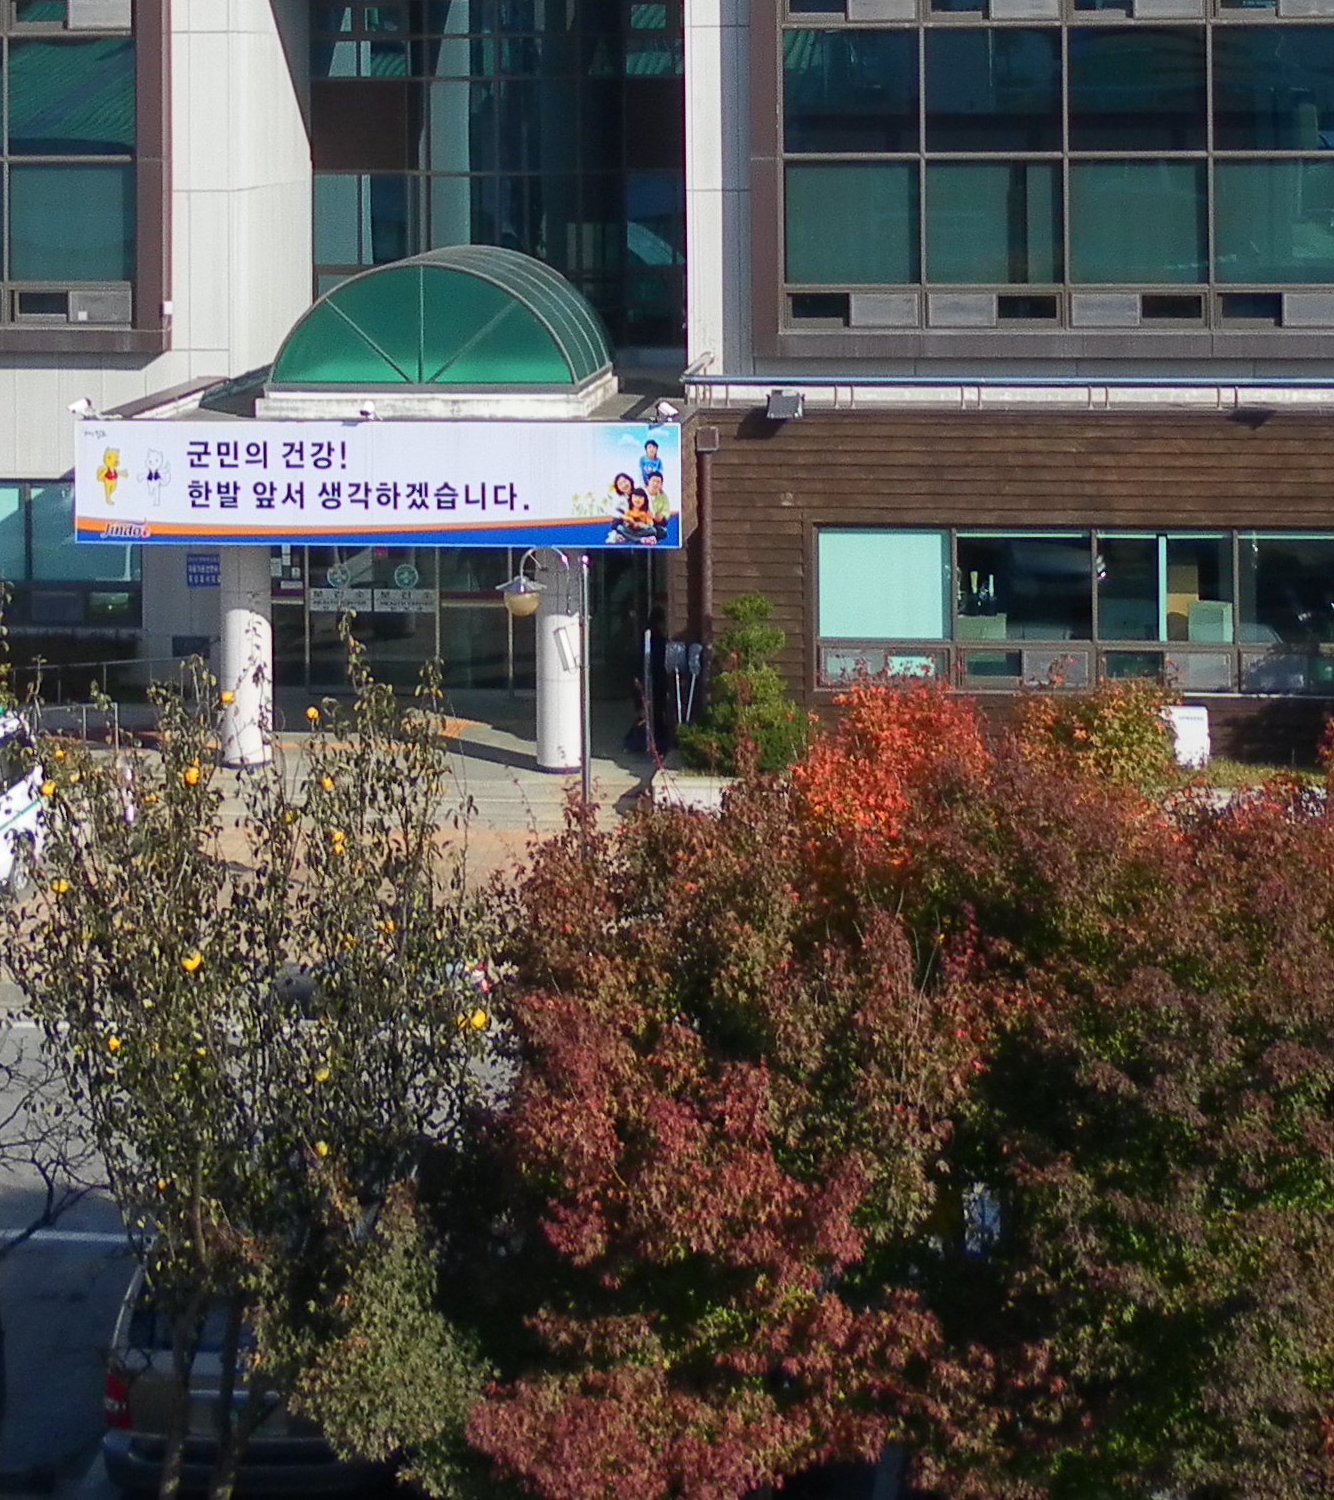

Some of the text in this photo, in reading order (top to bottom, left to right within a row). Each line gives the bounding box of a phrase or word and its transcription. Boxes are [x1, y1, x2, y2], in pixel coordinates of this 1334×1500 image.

[187, 441, 347, 470] 군민의 건강!
[188, 480, 530, 511] 한발 앞서 생각하겠습니다.
